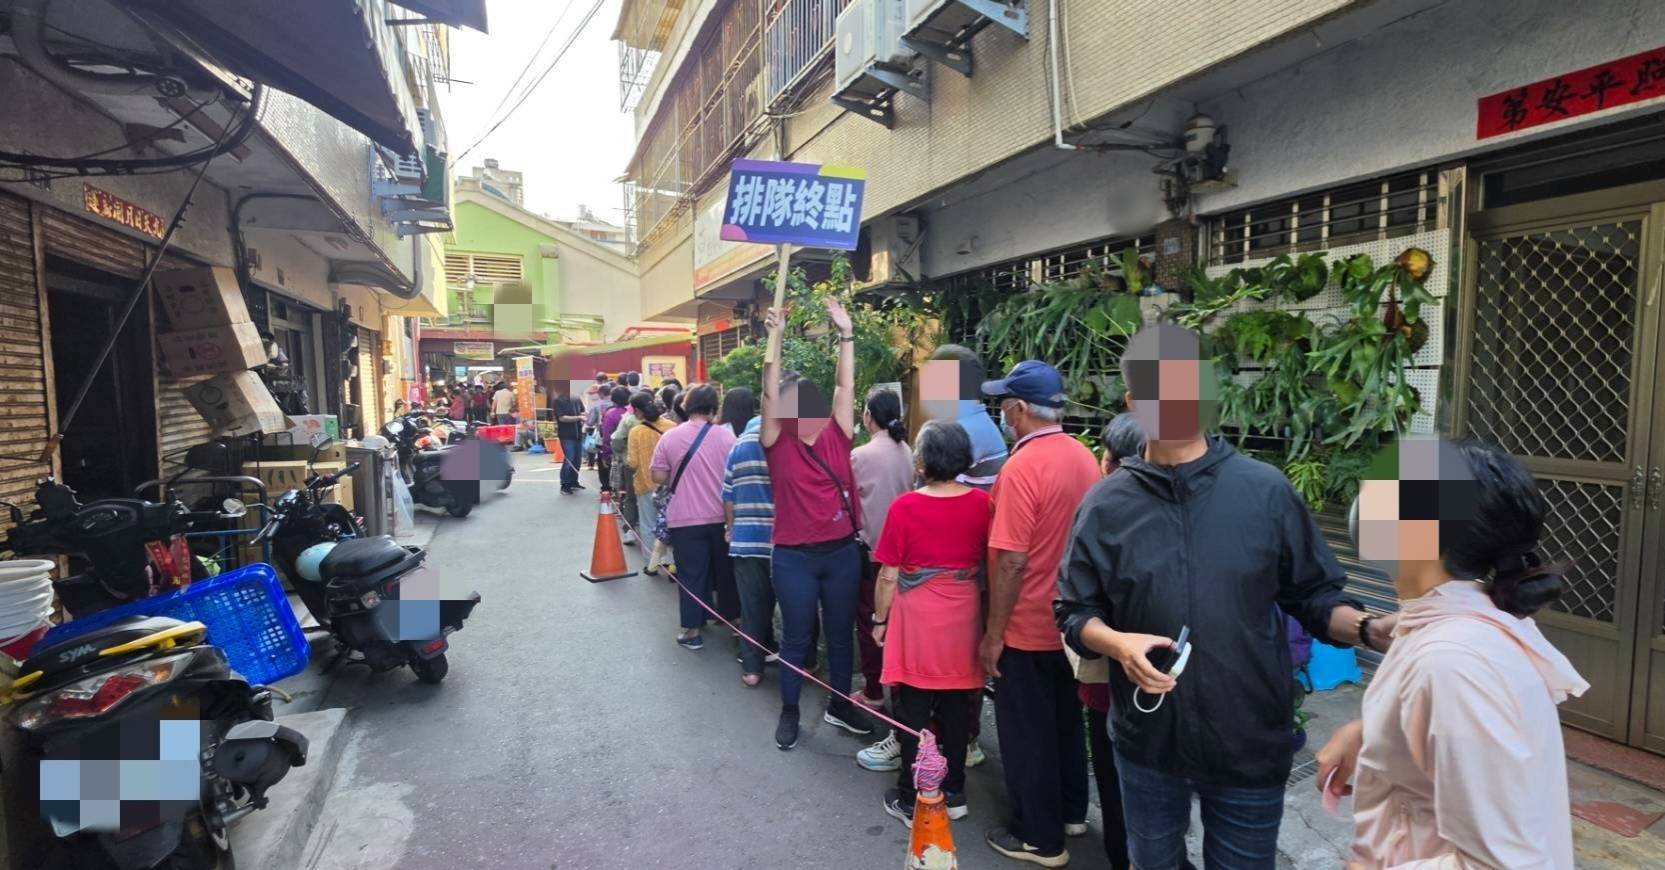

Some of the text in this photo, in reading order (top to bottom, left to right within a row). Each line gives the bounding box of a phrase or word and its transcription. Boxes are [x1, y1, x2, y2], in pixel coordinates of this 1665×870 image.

[730, 175, 857, 232] 排隊終點
[58, 643, 97, 663] SYM
